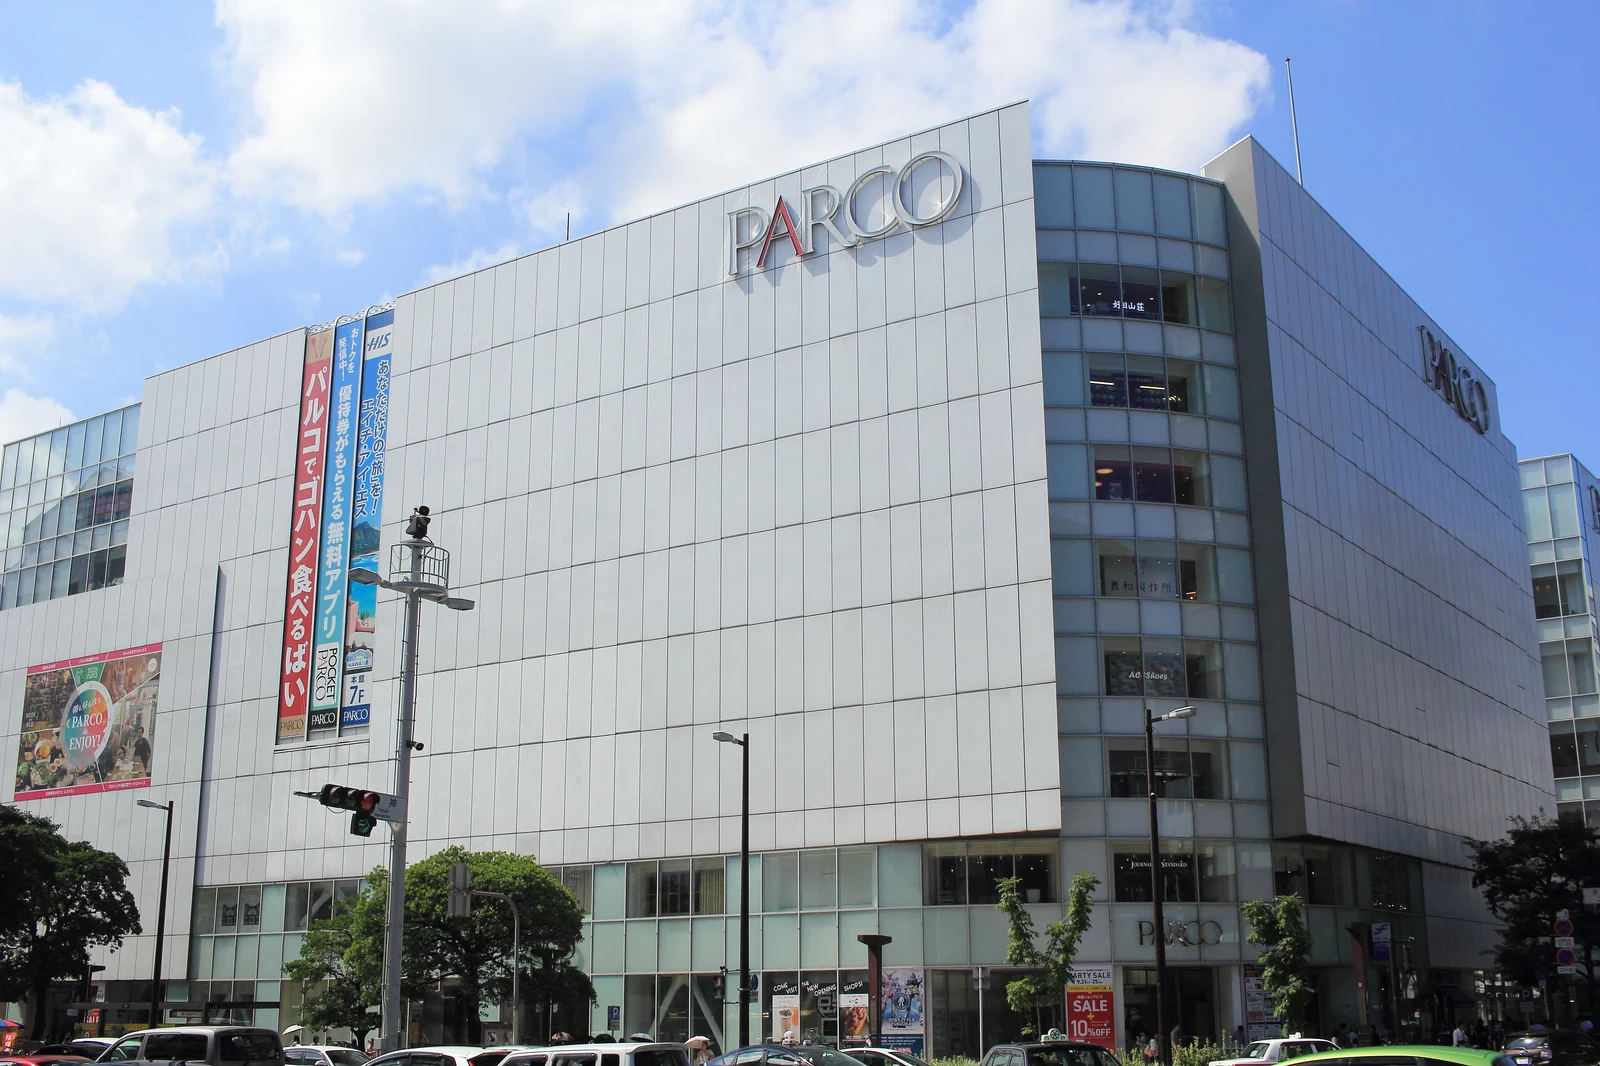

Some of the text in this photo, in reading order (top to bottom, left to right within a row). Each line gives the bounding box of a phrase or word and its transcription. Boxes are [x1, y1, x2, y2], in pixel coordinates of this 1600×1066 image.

[727, 150, 963, 276] PARCO
[1112, 300, 1145, 311] 好日山荘
[366, 332, 392, 352] HIS
[348, 327, 360, 374] おトクを
[1417, 325, 1489, 435] PARCO
[354, 398, 375, 518] エイチ・アイ・エス
[323, 384, 353, 639] 優待券がもらえる無料アプリ
[284, 366, 328, 708] パルコでゴハン食べるばい
[315, 649, 329, 701] PARCO
[326, 648, 338, 700] POCKET
[350, 674, 365, 684] 本館
[1145, 671, 1168, 681] Shoes
[349, 685, 365, 704] 7F
[71, 712, 103, 729] PARCO
[311, 712, 336, 725] PARCO
[343, 708, 369, 722] PARCO
[281, 718, 304, 732] PARCO
[69, 734, 101, 751] ENJOY!
[1131, 861, 1151, 870] JOURNA
[773, 982, 789, 992] COME
[785, 986, 798, 995] VISIT
[806, 983, 819, 992] NEW
[814, 984, 837, 997] OPENING
[843, 981, 863, 992] SHOPS!
[612, 1007, 619, 1019] P
[1073, 1000, 1108, 1012] SALE
[1071, 1020, 1111, 1037] 10%OFF
